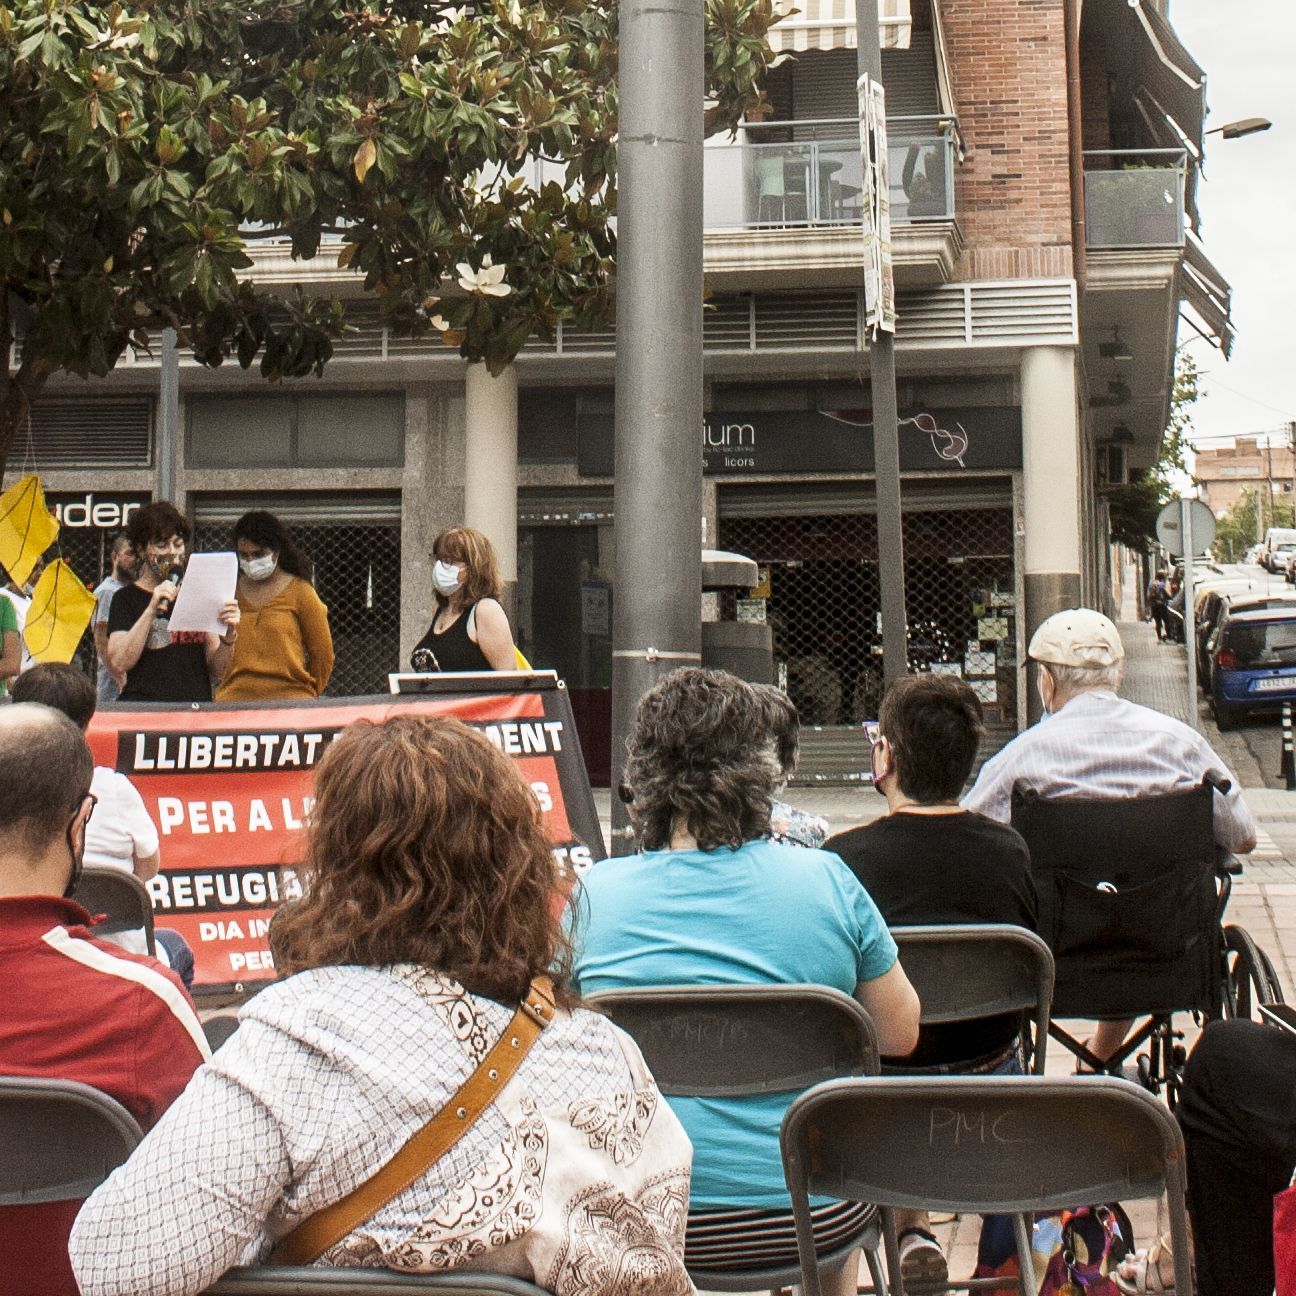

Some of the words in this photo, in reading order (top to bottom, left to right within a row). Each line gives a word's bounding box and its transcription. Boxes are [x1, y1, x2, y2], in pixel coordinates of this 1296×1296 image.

[725, 456, 755, 467] licors
[133, 733, 323, 770] LLIBERTAT
[158, 796, 238, 836] PER
[248, 797, 274, 832] A
[145, 870, 307, 910] REFUGIA
[199, 920, 245, 943] DIA
[929, 1107, 1026, 1146] PMC
